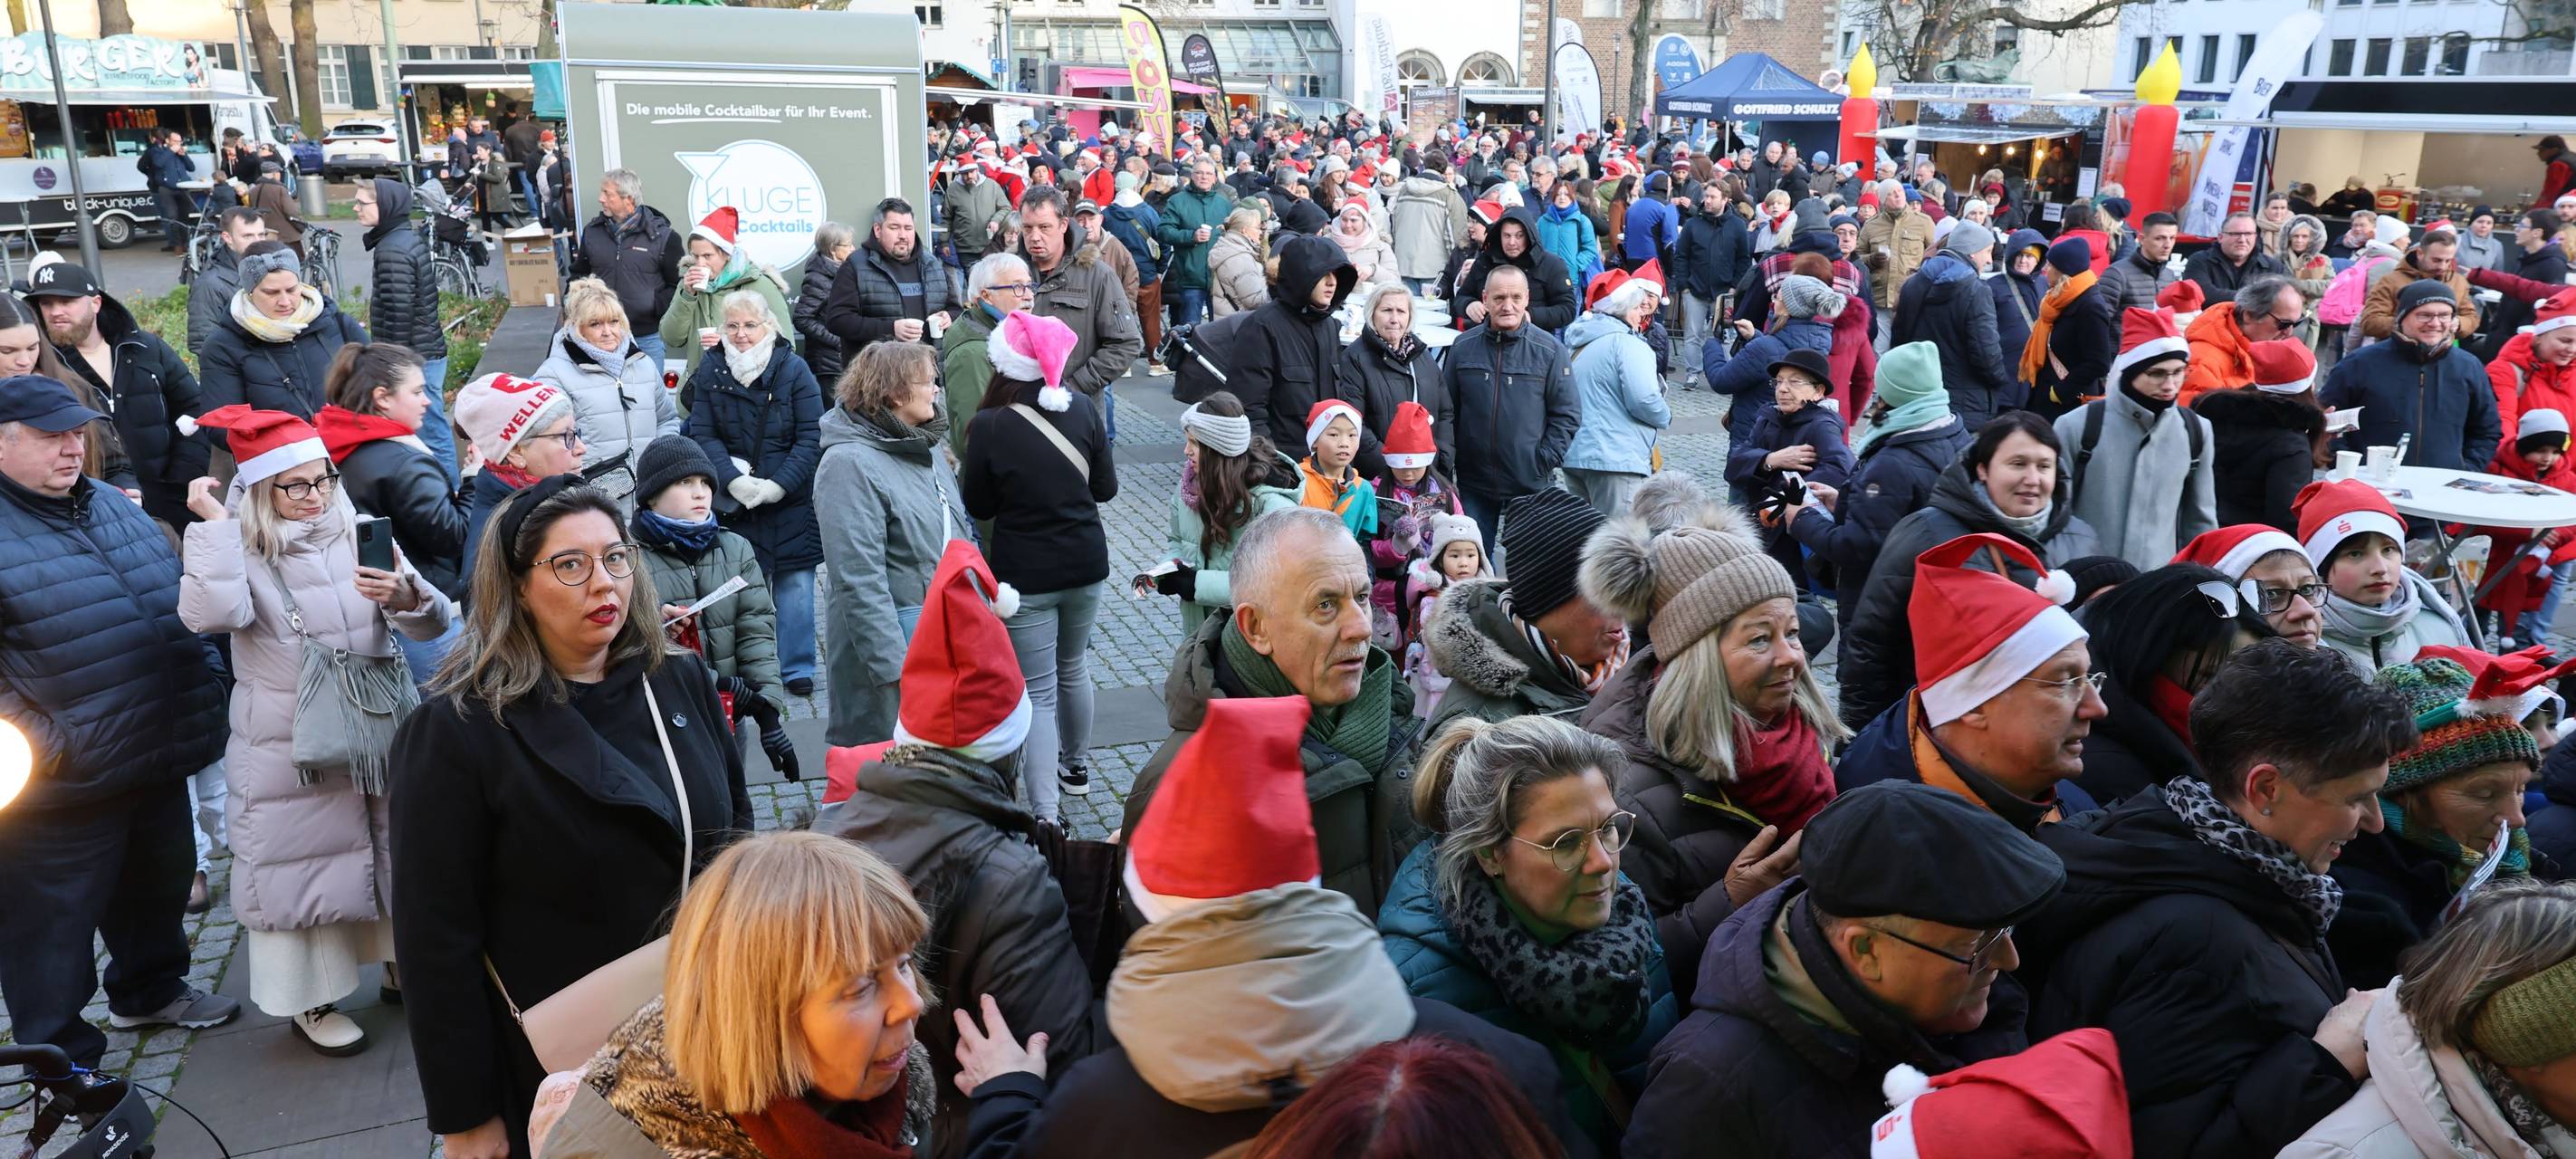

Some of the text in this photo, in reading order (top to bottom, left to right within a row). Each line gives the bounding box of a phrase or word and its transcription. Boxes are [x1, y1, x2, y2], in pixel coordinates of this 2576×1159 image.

[0, 39, 181, 82] BURGER
[626, 103, 872, 119] Die mobile Cocktailbar für Ihr Event.
[1733, 103, 1840, 115] GOTTFRIED SCHULTZ
[63, 196, 155, 210] blck-unique.c
[701, 182, 812, 214] KLUGE
[737, 218, 813, 233] Cocktails
[499, 387, 559, 442] WELLEN
